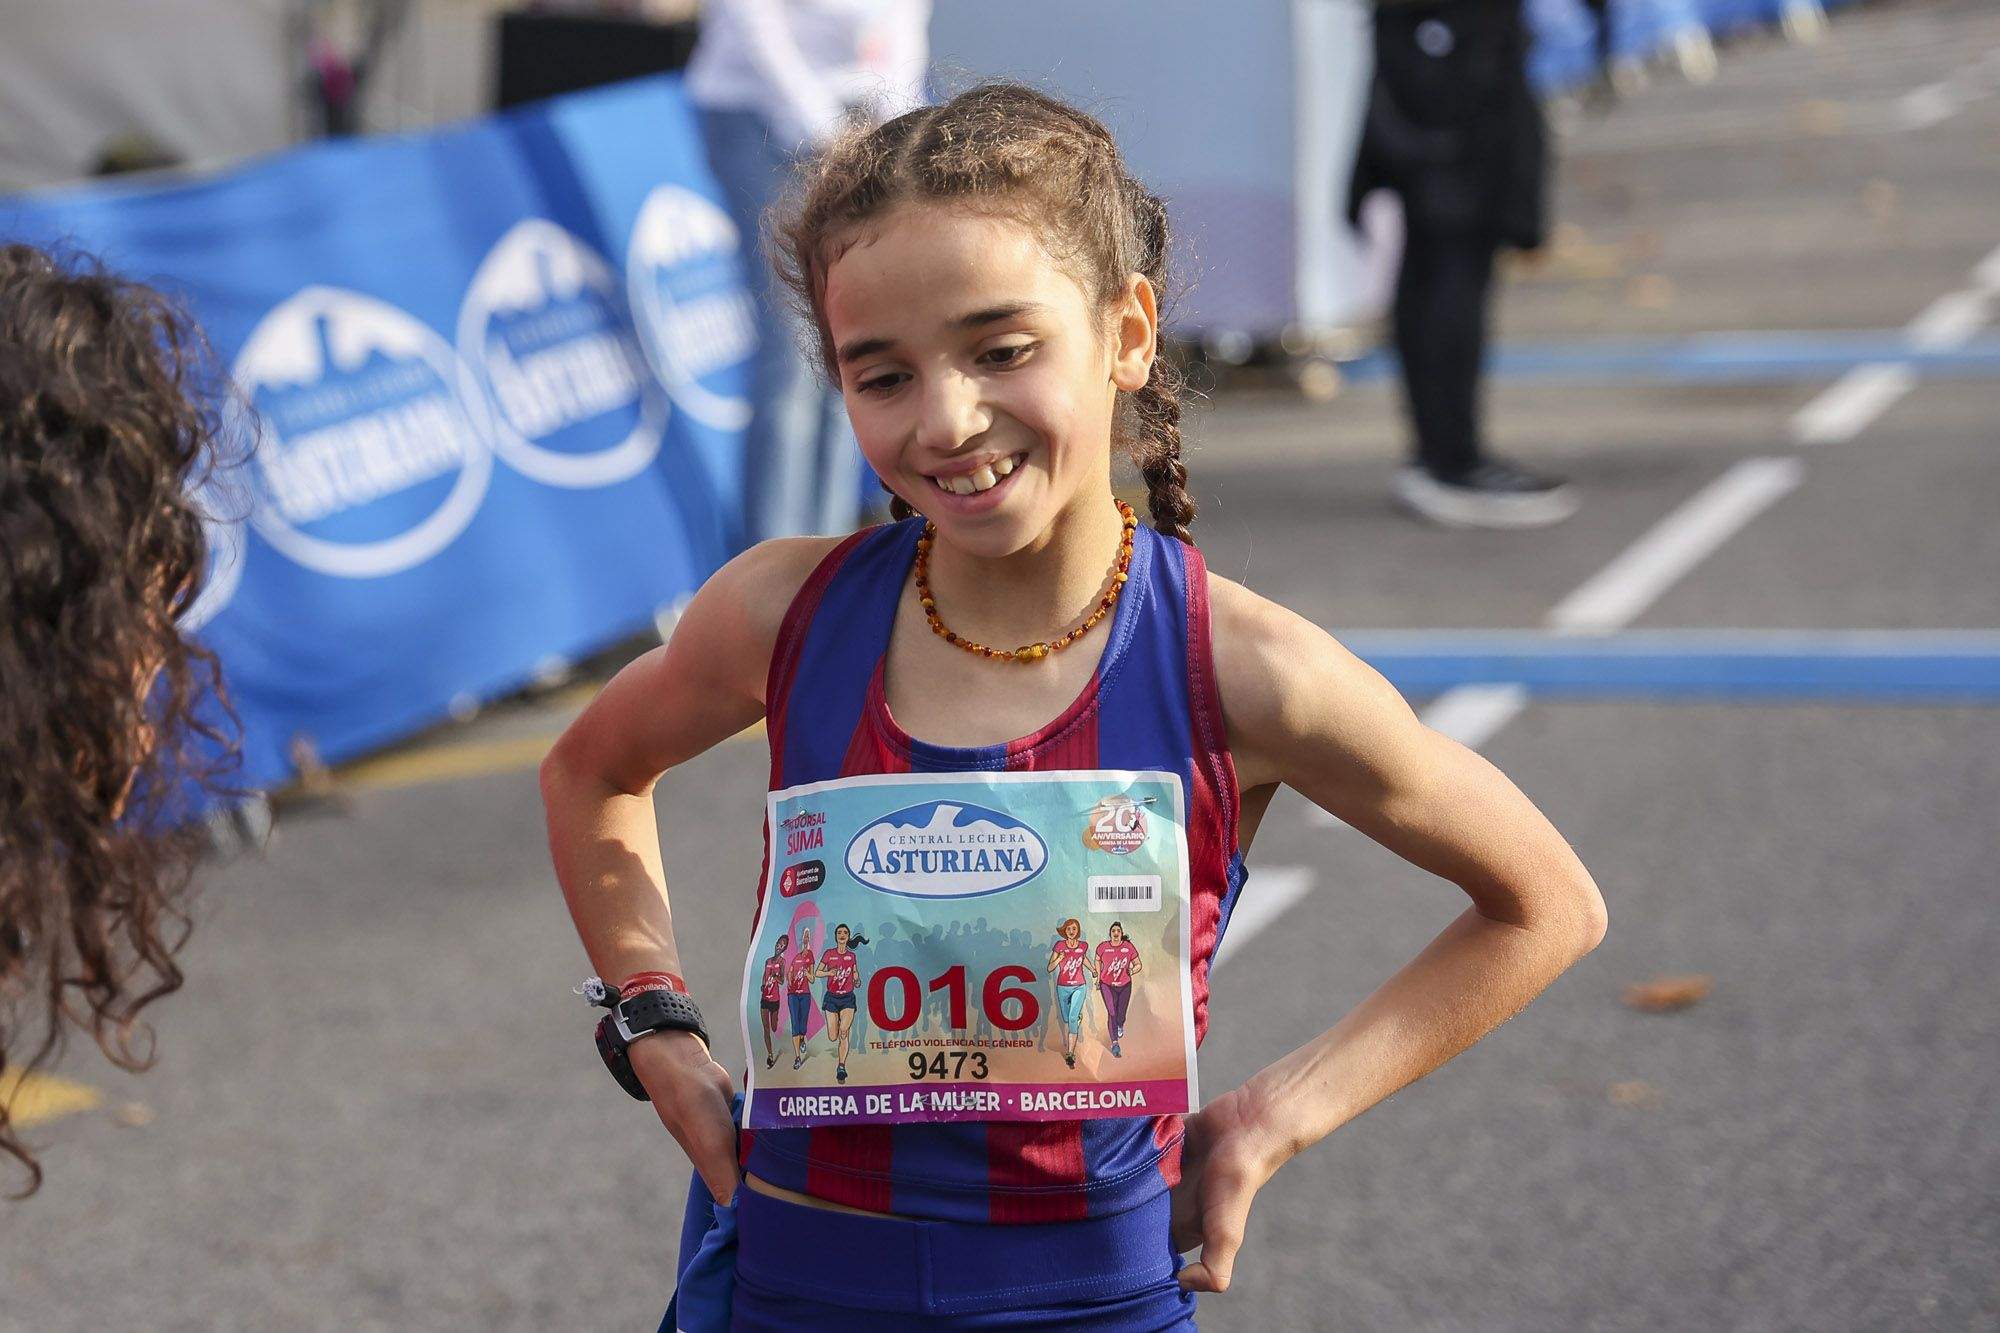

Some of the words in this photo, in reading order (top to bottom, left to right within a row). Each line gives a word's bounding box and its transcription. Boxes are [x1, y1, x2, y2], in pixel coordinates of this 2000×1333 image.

[787, 827, 824, 855] SUMA
[888, 834, 952, 845] CENTRAL
[959, 833, 1026, 844] LECHERA
[1091, 832, 1145, 840] ANIVERSARIO
[858, 838, 1033, 875] ASTURIANA
[867, 965, 1040, 1032] 016
[870, 1038, 921, 1050] TELÉFONO
[923, 1039, 975, 1047] VIOLENCIA
[978, 1039, 990, 1047] DE
[992, 1038, 1034, 1048] GÉNERO
[908, 1051, 989, 1080] 9473
[779, 1094, 859, 1116] CARRERA
[866, 1093, 892, 1115] DE
[899, 1092, 924, 1113] LA
[931, 1091, 1000, 1111] MUJER
[1021, 1089, 1147, 1112] BARCELONA
